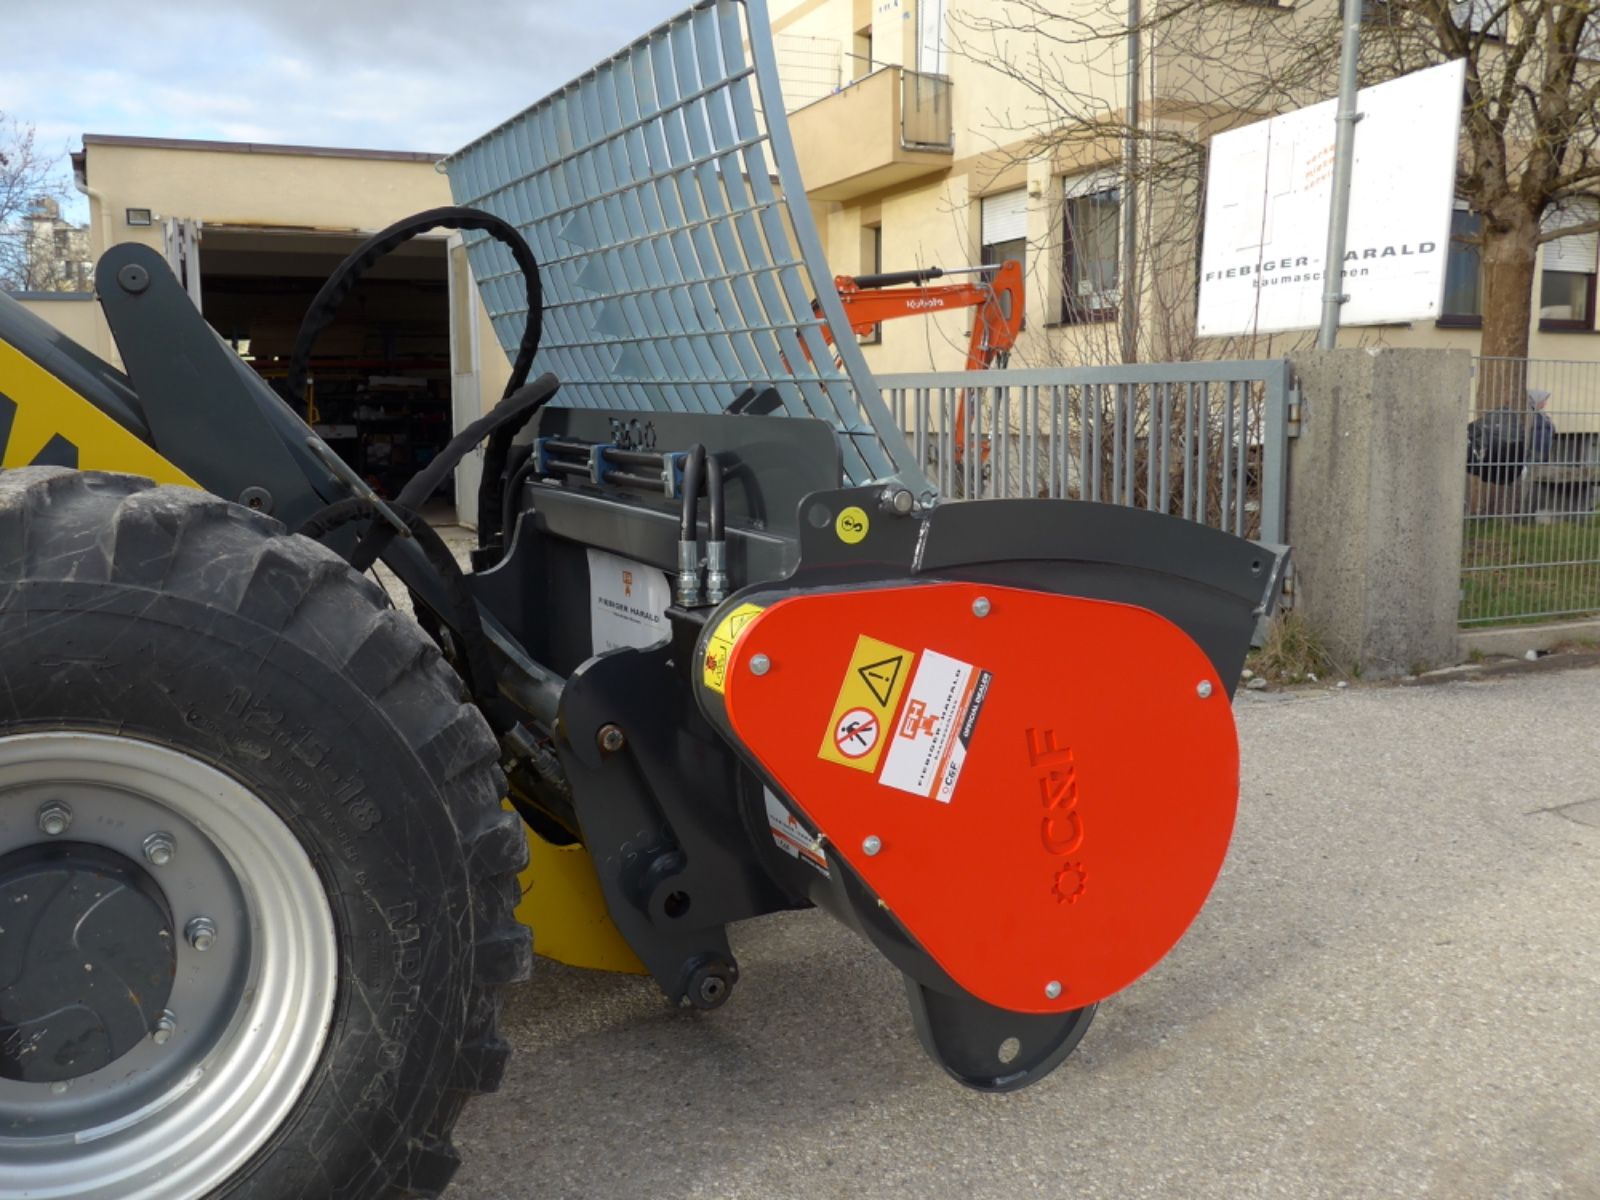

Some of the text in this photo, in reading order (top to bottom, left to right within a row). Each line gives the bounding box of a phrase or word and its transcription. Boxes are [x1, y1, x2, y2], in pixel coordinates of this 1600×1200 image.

[1205, 256, 1309, 282] FIEBIGER
[1343, 242, 1437, 261] ARALD
[1252, 266, 1370, 288] baumascnen
[906, 297, 945, 310] Kubota
[630, 606, 660, 623] HARALD
[963, 702, 978, 738] OFFICIAL
